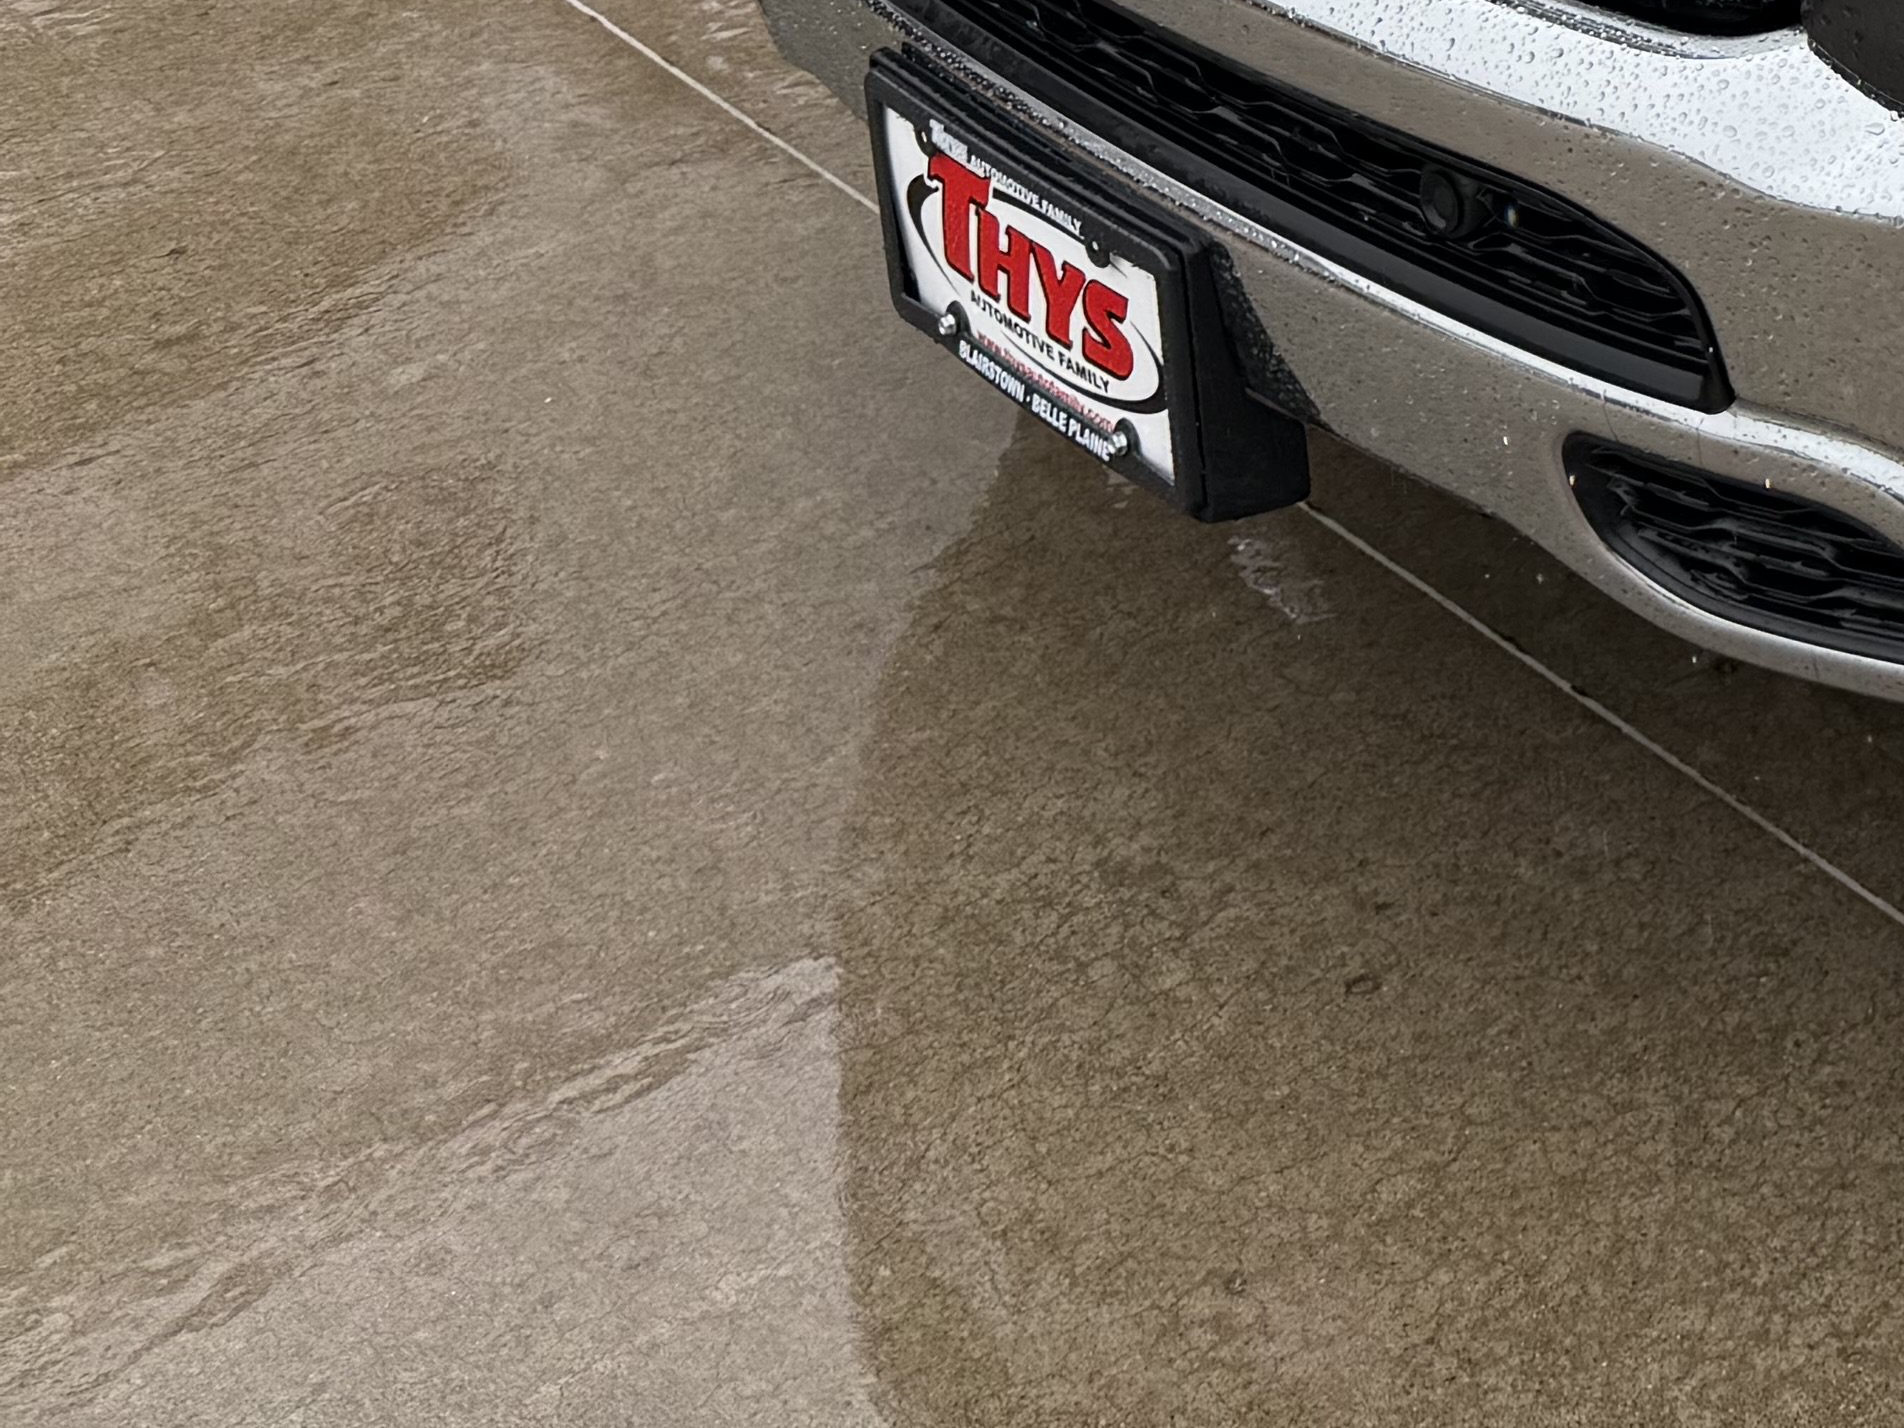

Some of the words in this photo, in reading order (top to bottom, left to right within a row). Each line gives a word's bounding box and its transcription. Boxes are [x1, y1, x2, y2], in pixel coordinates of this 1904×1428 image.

[927, 152, 1134, 381] THYS
[959, 340, 1026, 404] BLAIRSTOWN
[1031, 393, 1069, 435] BELLE
[1068, 417, 1112, 462] PLAINE
[971, 290, 1055, 361] AUTOMOTIVE
[1059, 351, 1110, 393] FAMILY
